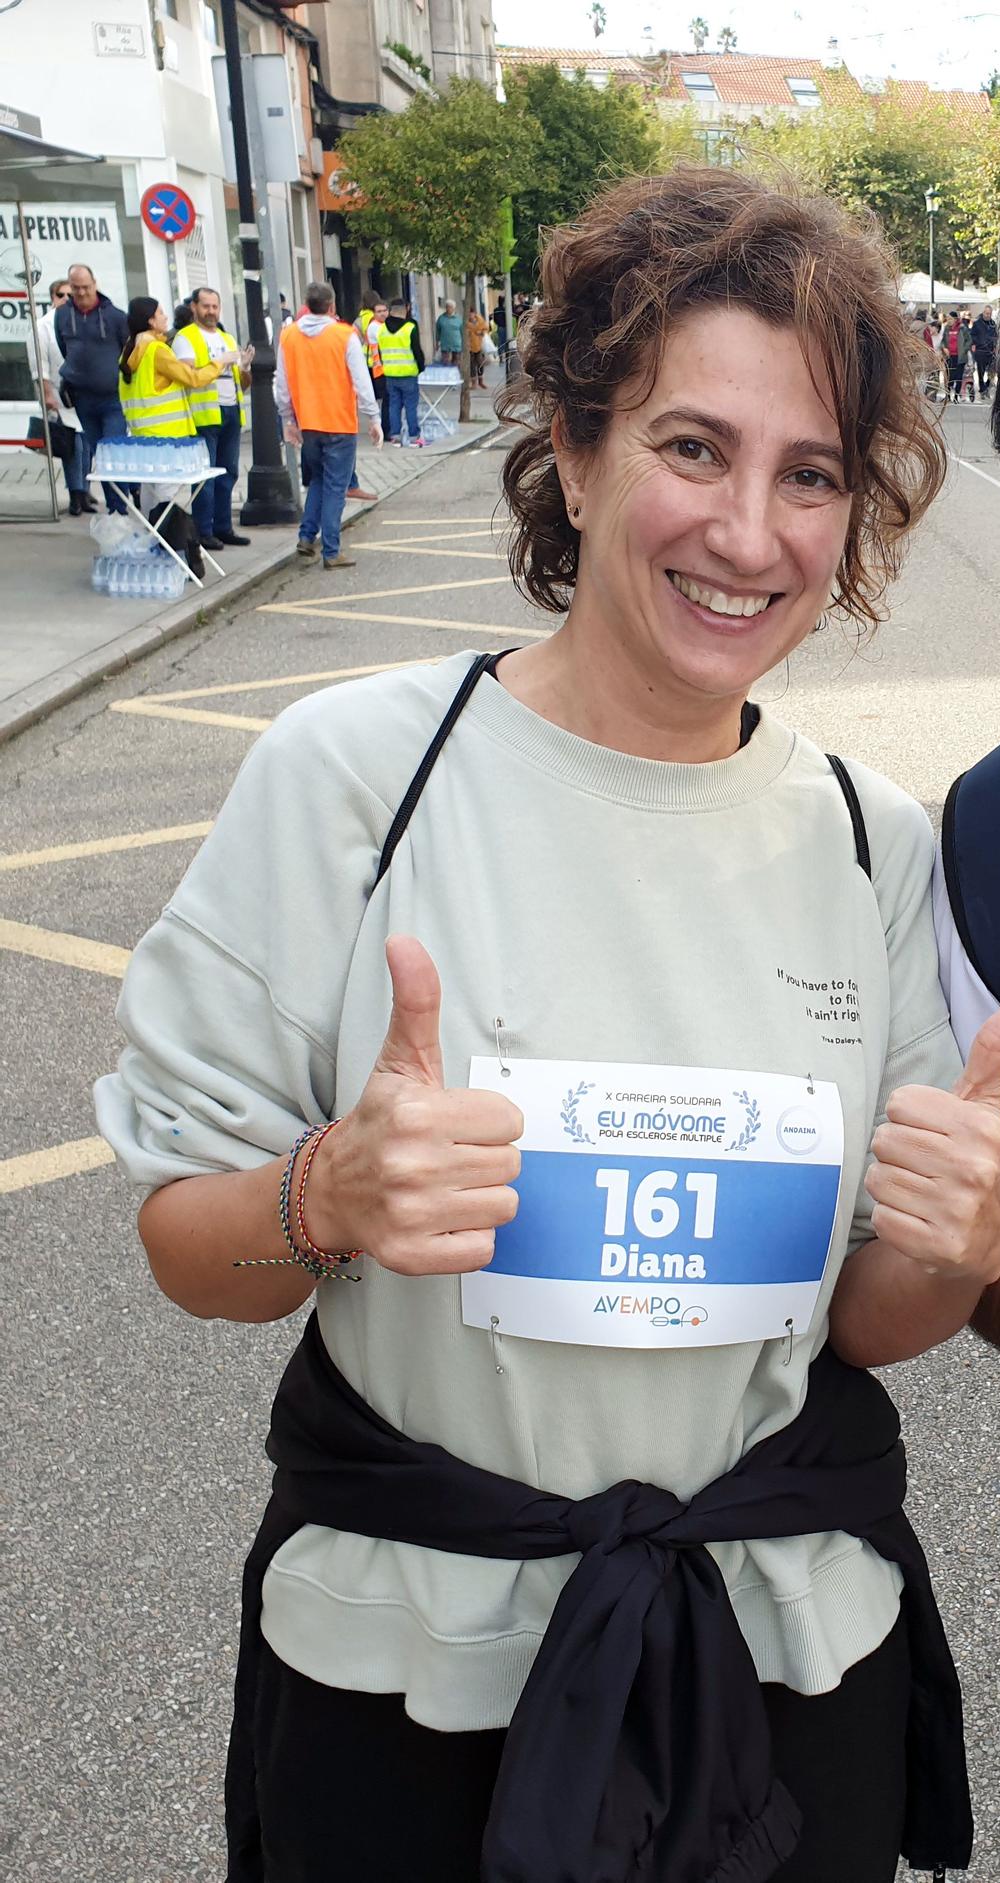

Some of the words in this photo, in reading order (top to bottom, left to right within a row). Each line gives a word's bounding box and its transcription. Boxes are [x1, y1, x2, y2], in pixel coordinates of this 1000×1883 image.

[777, 967, 784, 979] If
[786, 973, 800, 987] you
[801, 979, 828, 991] have
[831, 980, 844, 990] to
[830, 995, 842, 1005] to
[846, 993, 856, 1005] fit
[814, 1010, 838, 1021] ain't
[605, 1092, 612, 1101] X
[615, 1092, 667, 1105] CARREIRA
[670, 1096, 722, 1107] SOLIDARIA
[597, 1111, 625, 1129] EU
[632, 1108, 726, 1134] MÓVOME
[599, 1129, 624, 1139] POLA
[626, 1130, 676, 1141] ESCLEROSE
[680, 1132, 722, 1143] MÚLTIPLE
[783, 1125, 816, 1135] ANDAINA
[595, 1168, 718, 1239] 161
[600, 1243, 707, 1279] Diana
[593, 1296, 681, 1315] AVEMPO
